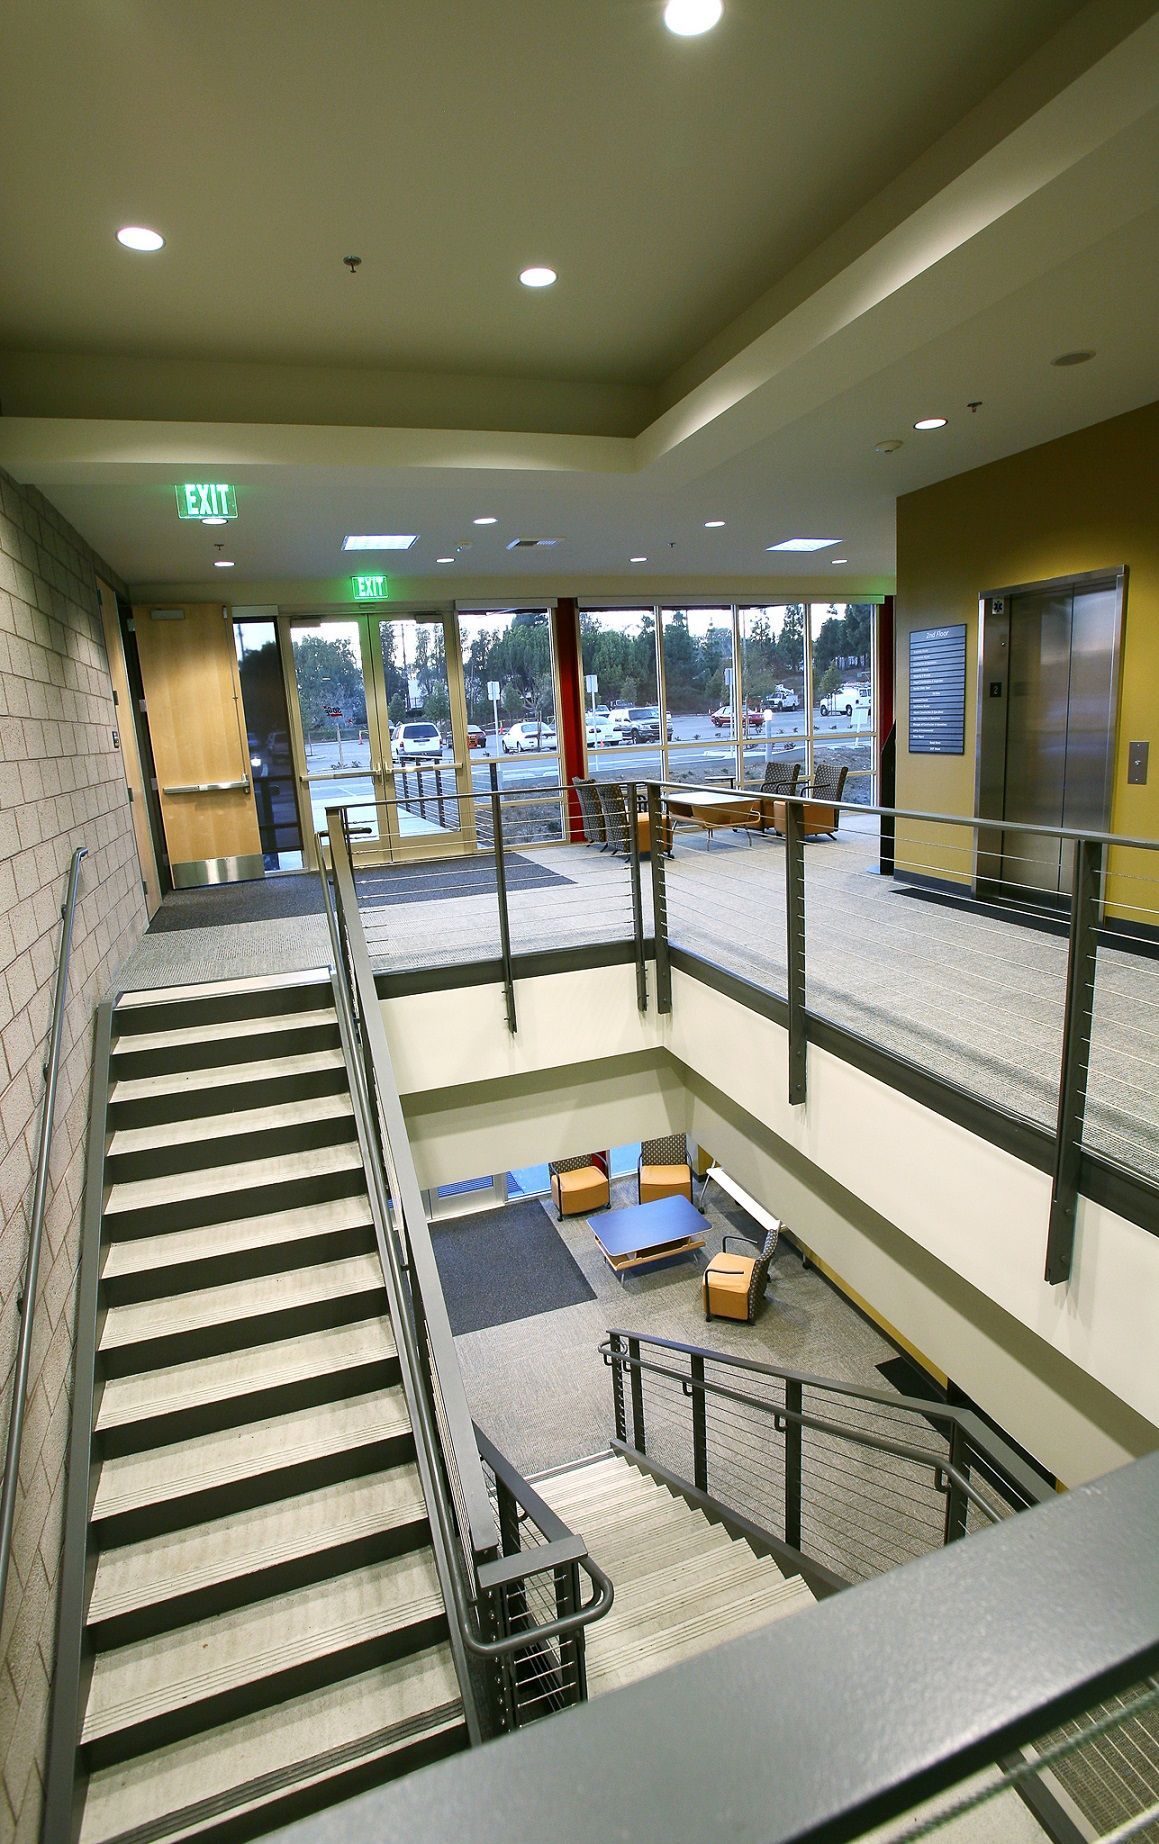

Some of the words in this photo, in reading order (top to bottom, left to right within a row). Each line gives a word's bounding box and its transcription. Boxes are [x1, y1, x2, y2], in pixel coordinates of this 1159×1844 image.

[185, 483, 228, 514] EXIT
[358, 576, 384, 596] EXIT
[926, 631, 935, 639] 2nd
[936, 630, 949, 638] Floor
